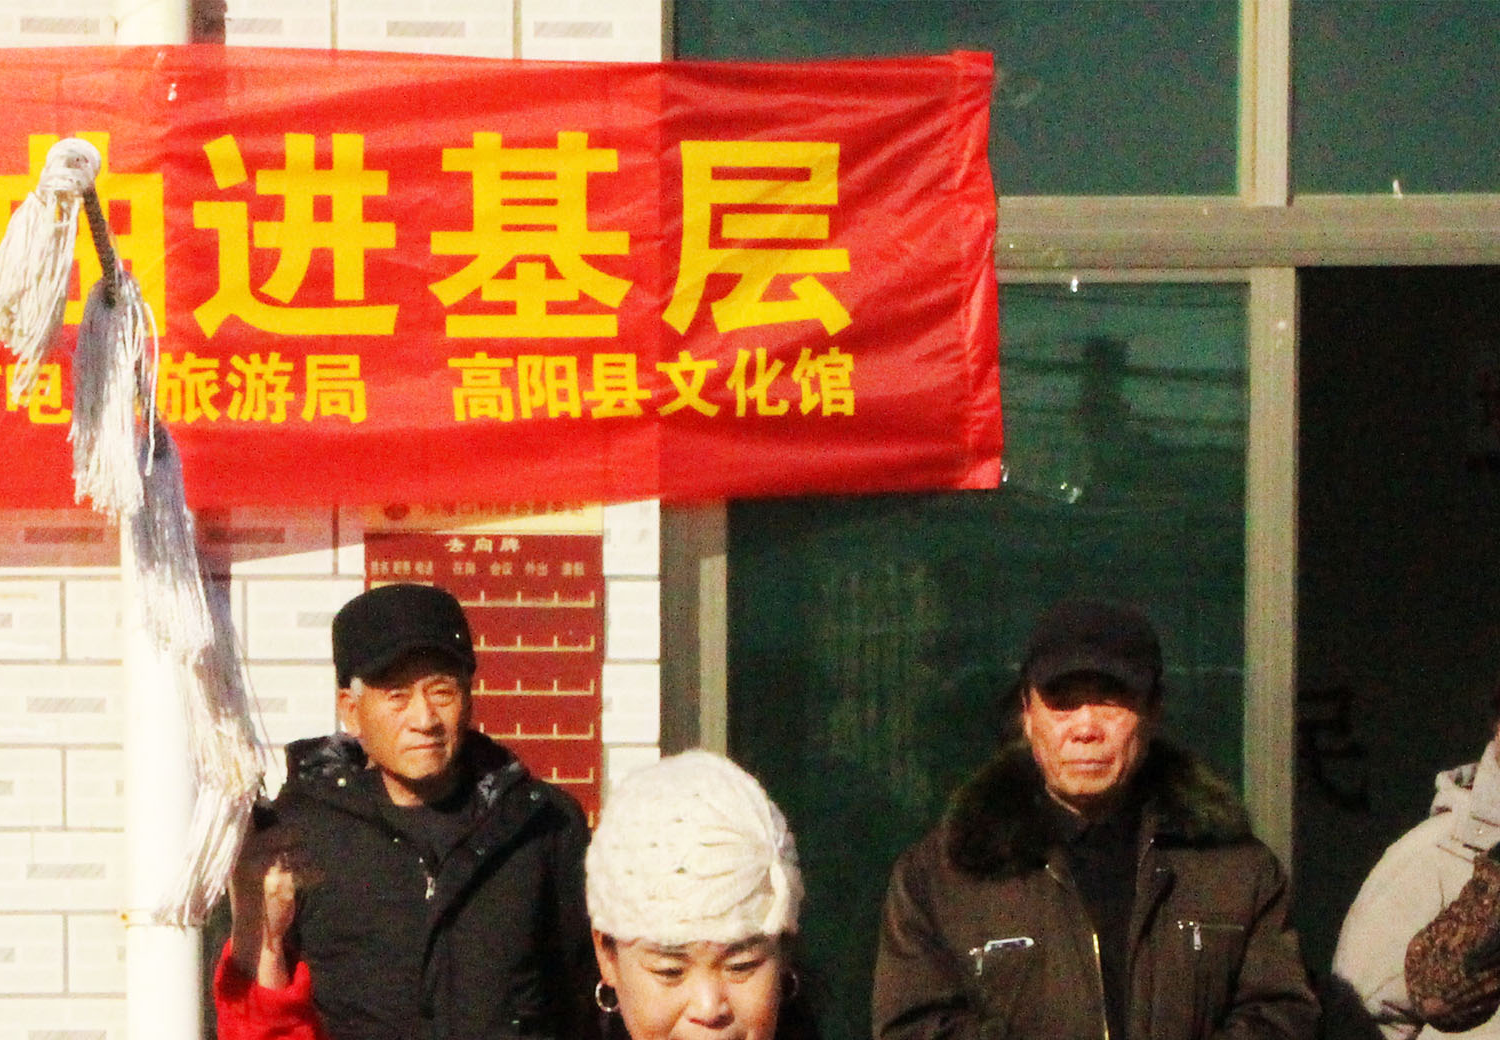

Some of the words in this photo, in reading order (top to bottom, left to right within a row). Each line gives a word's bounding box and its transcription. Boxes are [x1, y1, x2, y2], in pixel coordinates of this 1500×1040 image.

[448, 347, 855, 421] 高阳县文化馆
